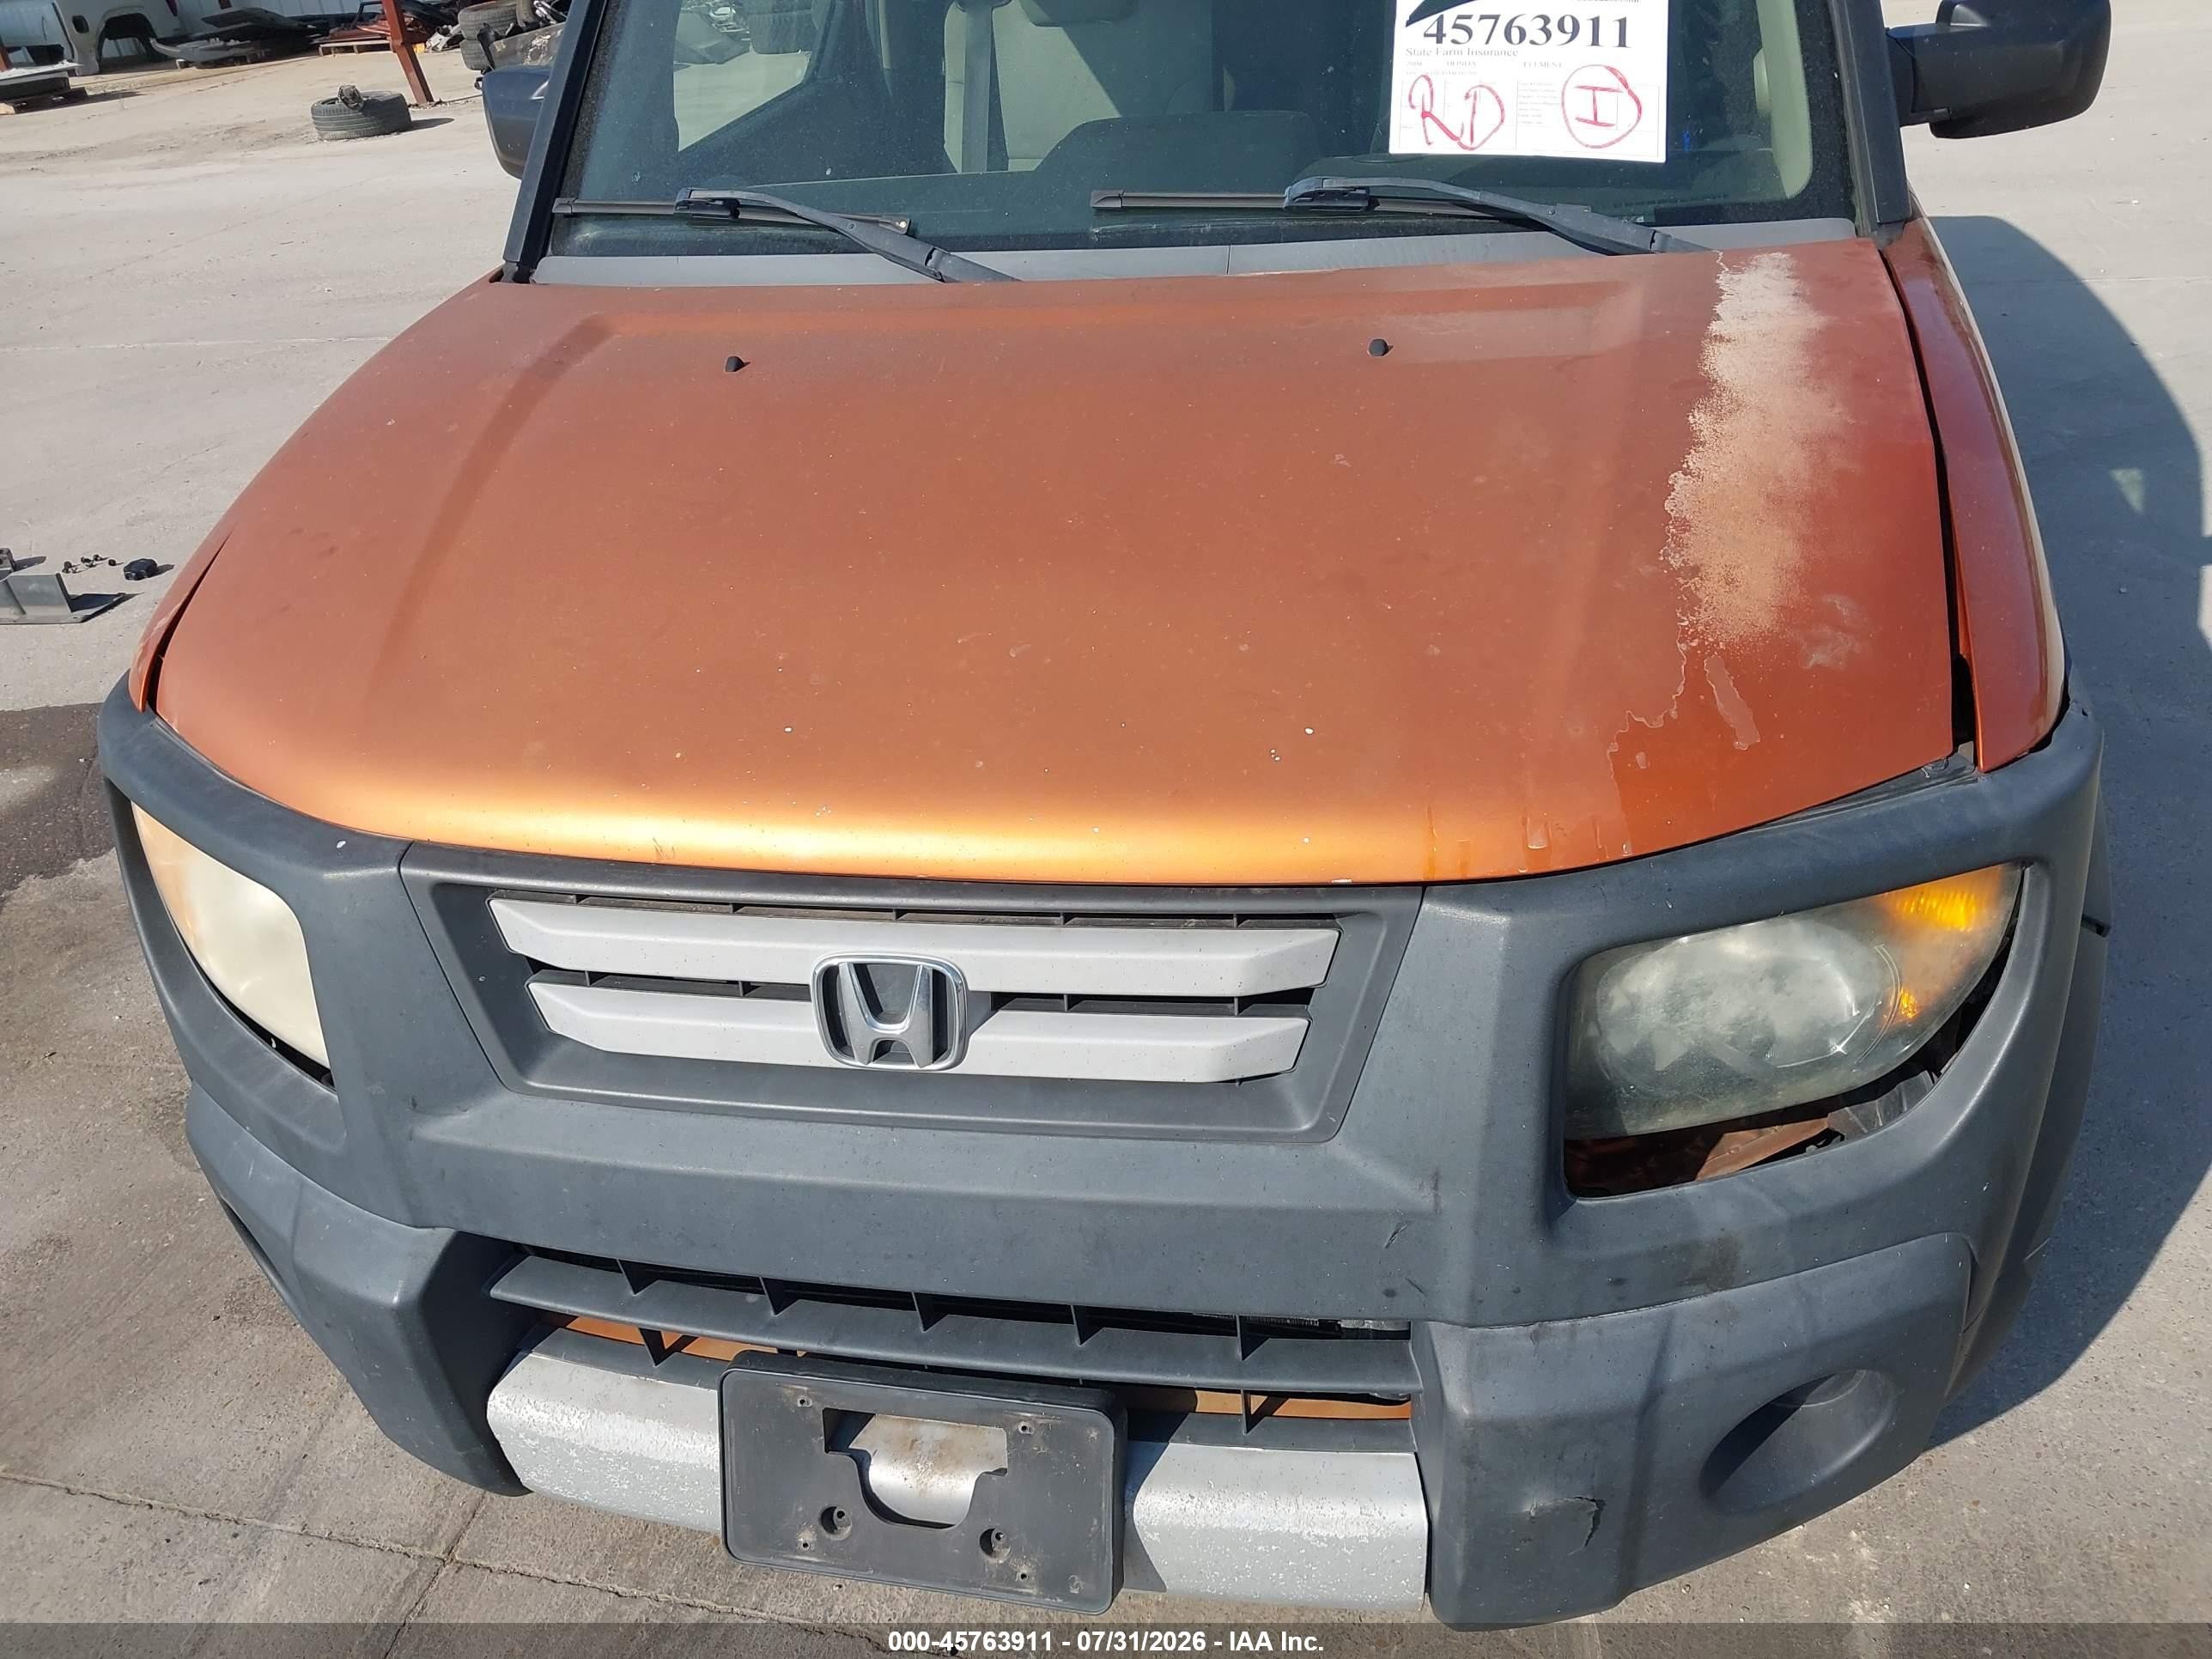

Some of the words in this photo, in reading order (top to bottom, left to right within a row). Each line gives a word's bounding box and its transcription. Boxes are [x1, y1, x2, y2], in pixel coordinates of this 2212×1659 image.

[1423, 14, 1632, 48] 45763911
[1405, 47, 1432, 57] State
[1436, 47, 1463, 56] Farm
[1467, 47, 1519, 57] Insurance
